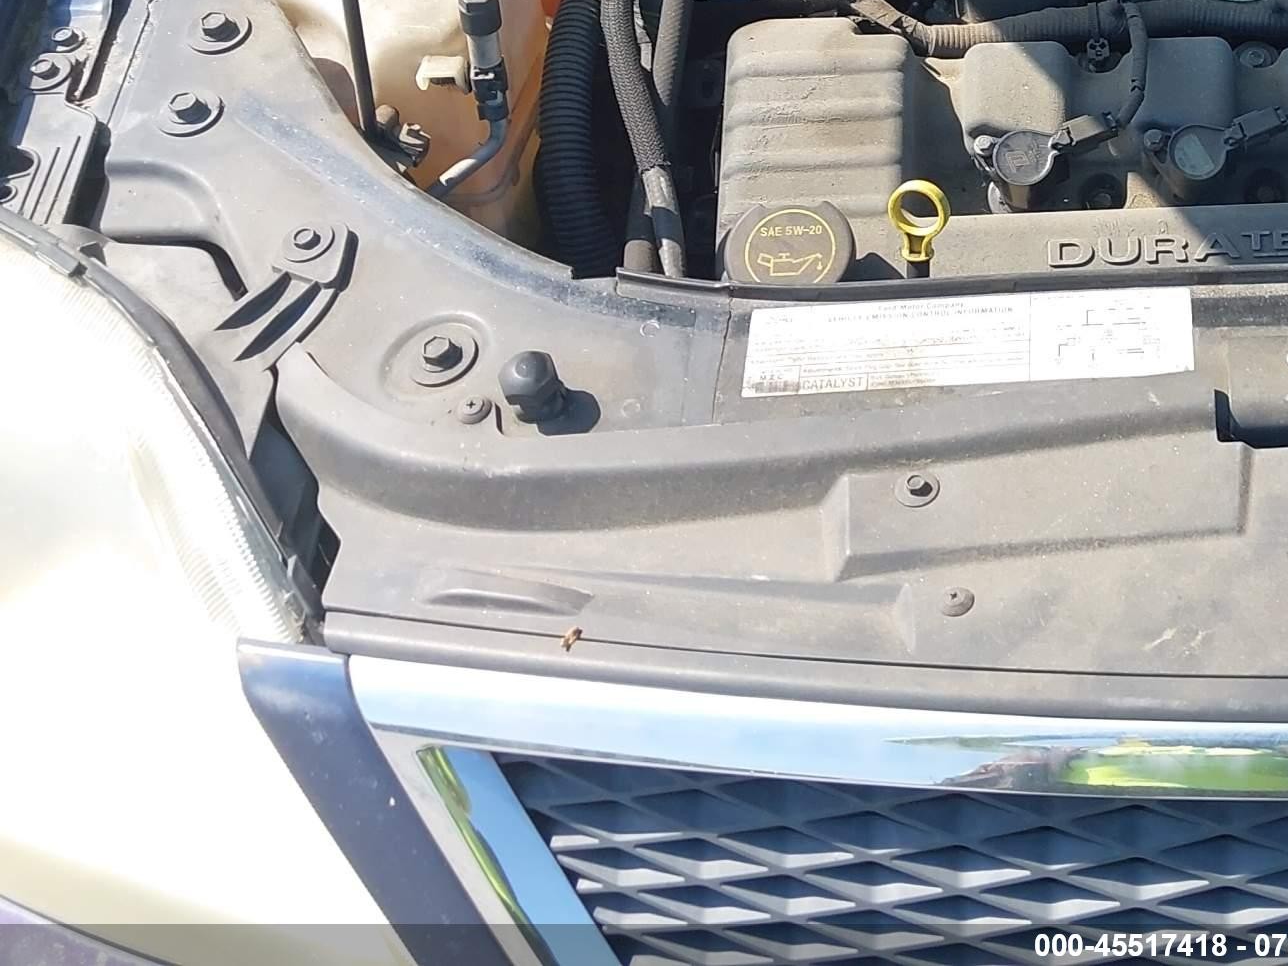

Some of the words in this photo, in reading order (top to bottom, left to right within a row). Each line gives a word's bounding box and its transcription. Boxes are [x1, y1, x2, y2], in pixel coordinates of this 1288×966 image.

[760, 227, 783, 237] SAE
[785, 225, 823, 235] 5W-20
[802, 376, 865, 390] CATALYST
